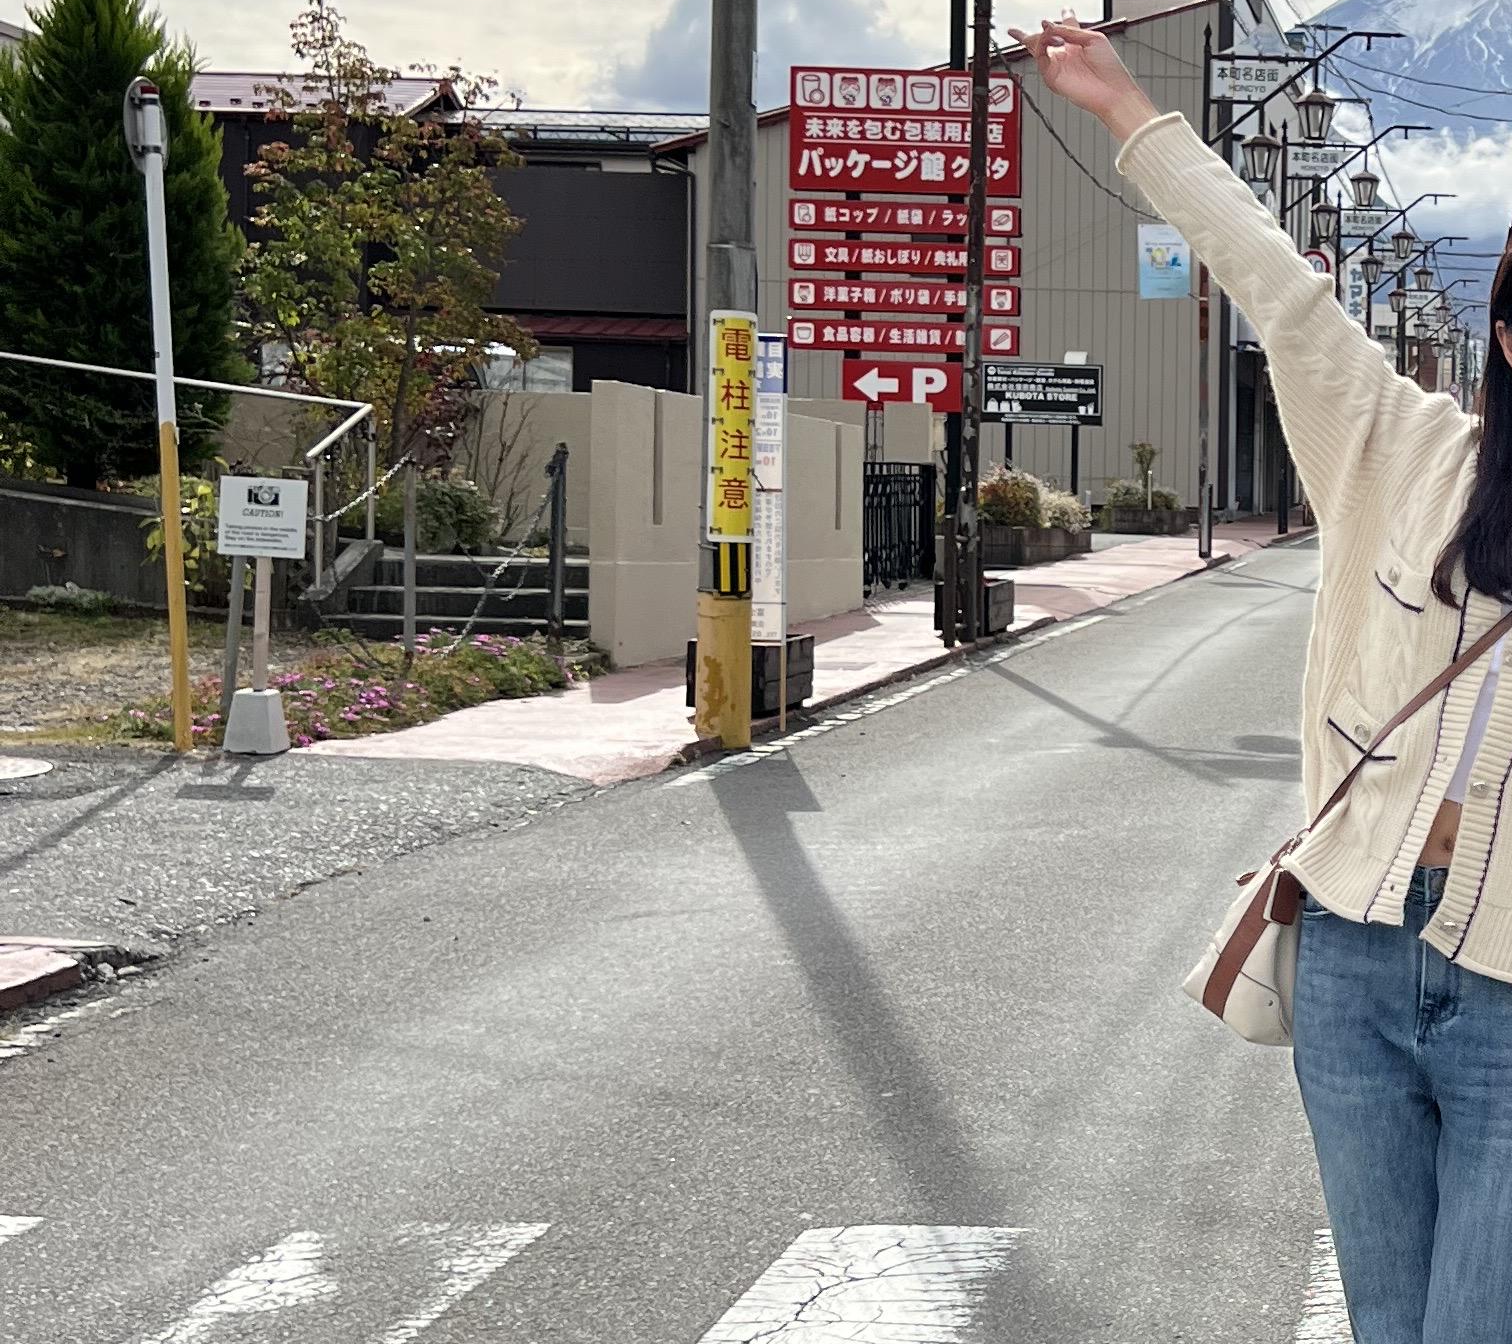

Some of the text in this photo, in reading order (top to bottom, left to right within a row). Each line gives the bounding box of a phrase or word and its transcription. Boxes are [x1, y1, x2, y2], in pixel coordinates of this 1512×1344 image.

[799, 147, 1010, 182] パッケージ館 クタ
[912, 367, 948, 404] P
[718, 327, 751, 510] 電柱注意
